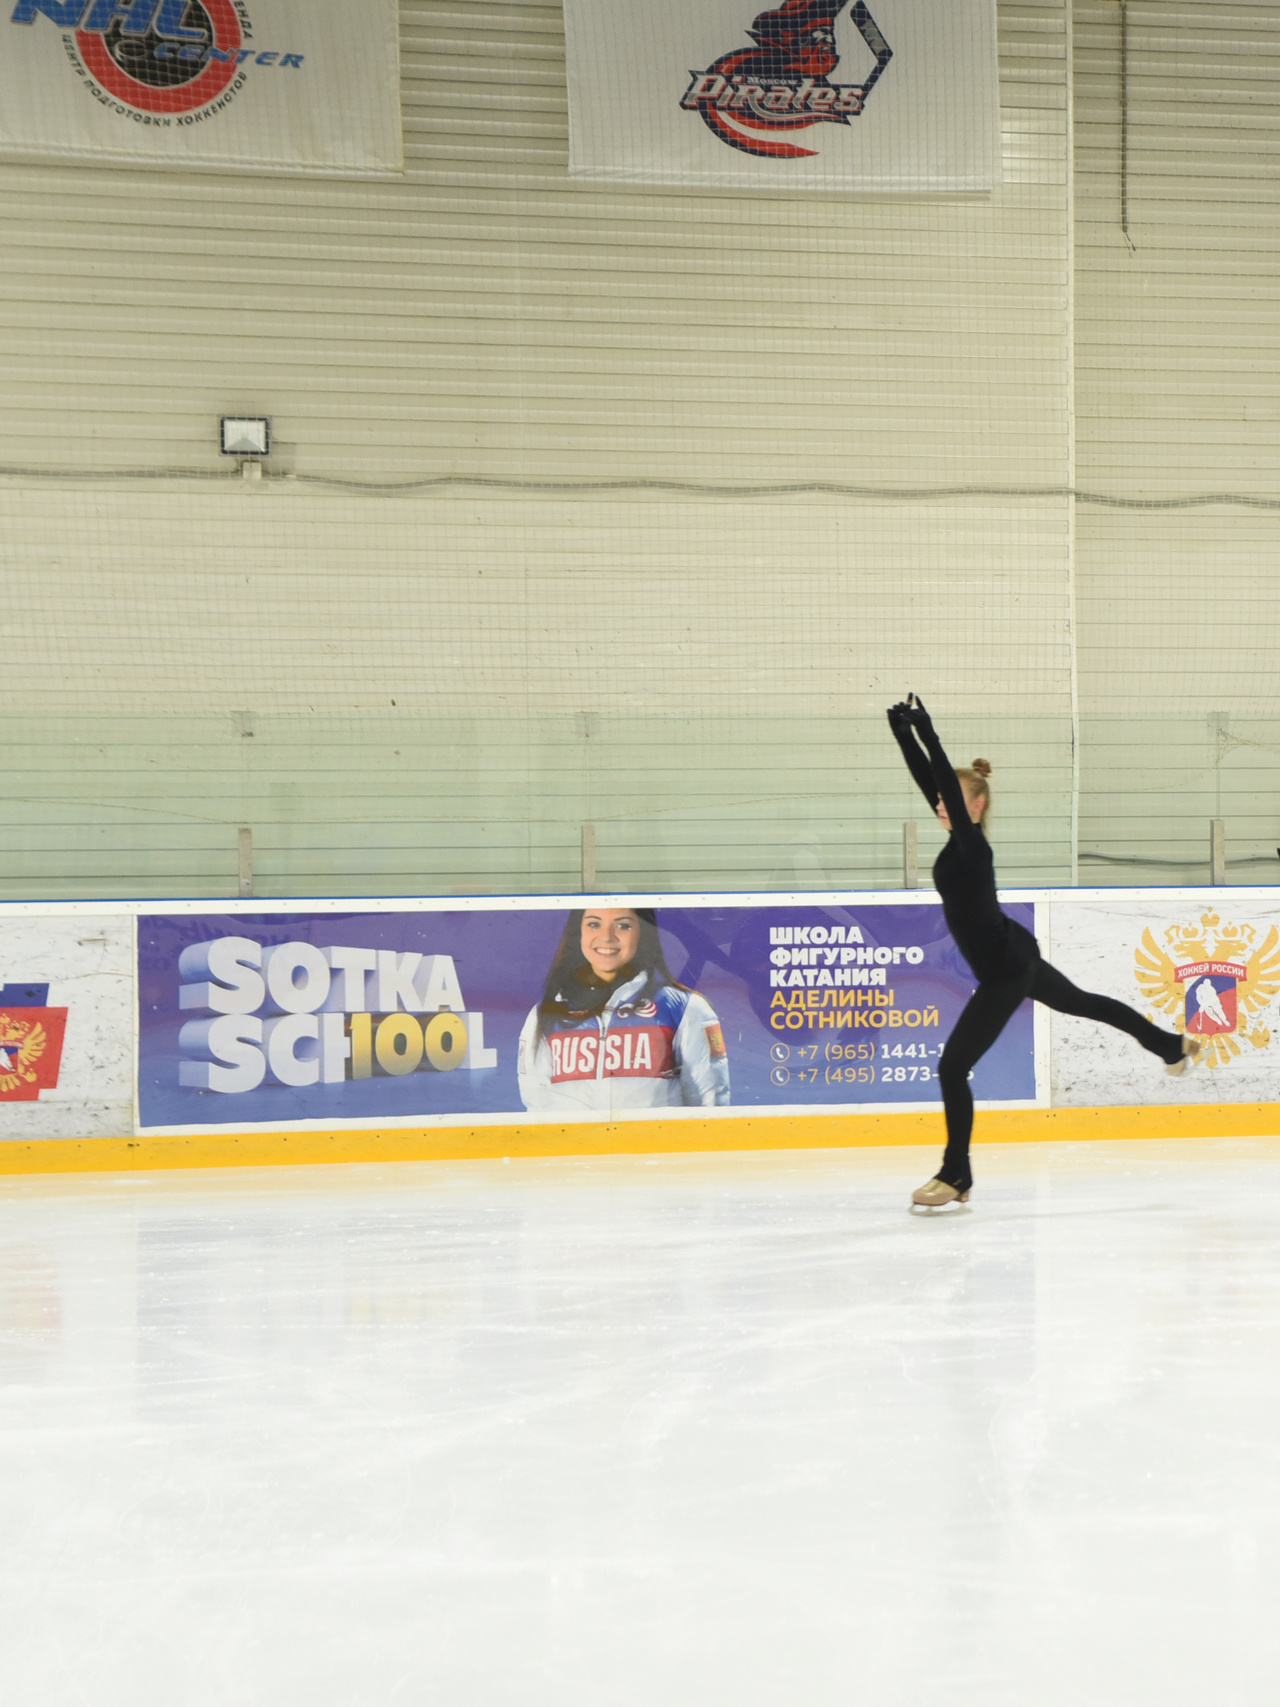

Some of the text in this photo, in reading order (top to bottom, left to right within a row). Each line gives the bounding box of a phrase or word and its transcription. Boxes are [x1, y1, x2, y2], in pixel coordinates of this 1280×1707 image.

[153, 42, 304, 68] CENTER
[61, 33, 86, 77] ЦЕНТР
[84, 79, 171, 127] ПОДГОТОВКИ
[747, 75, 799, 86] Moscow
[684, 74, 864, 111] Pirates
[769, 926, 864, 944] ШКОЛА
[769, 946, 924, 967] ФИГУРНОГО
[179, 936, 466, 1014] SOTKA
[769, 968, 887, 987] КАТАНИЯ
[1178, 963, 1244, 978] ХОККЕЙ РОССИИ
[769, 989, 894, 1010] АДЕЛИНЫ
[769, 1005, 939, 1030] СОТНИКОВОЙ
[551, 1032, 652, 1077] RUSSIA
[797, 1045, 818, 1060] +7
[824, 1042, 876, 1063] (965)
[797, 1069, 818, 1084] +7
[824, 1065, 876, 1086] (495)
